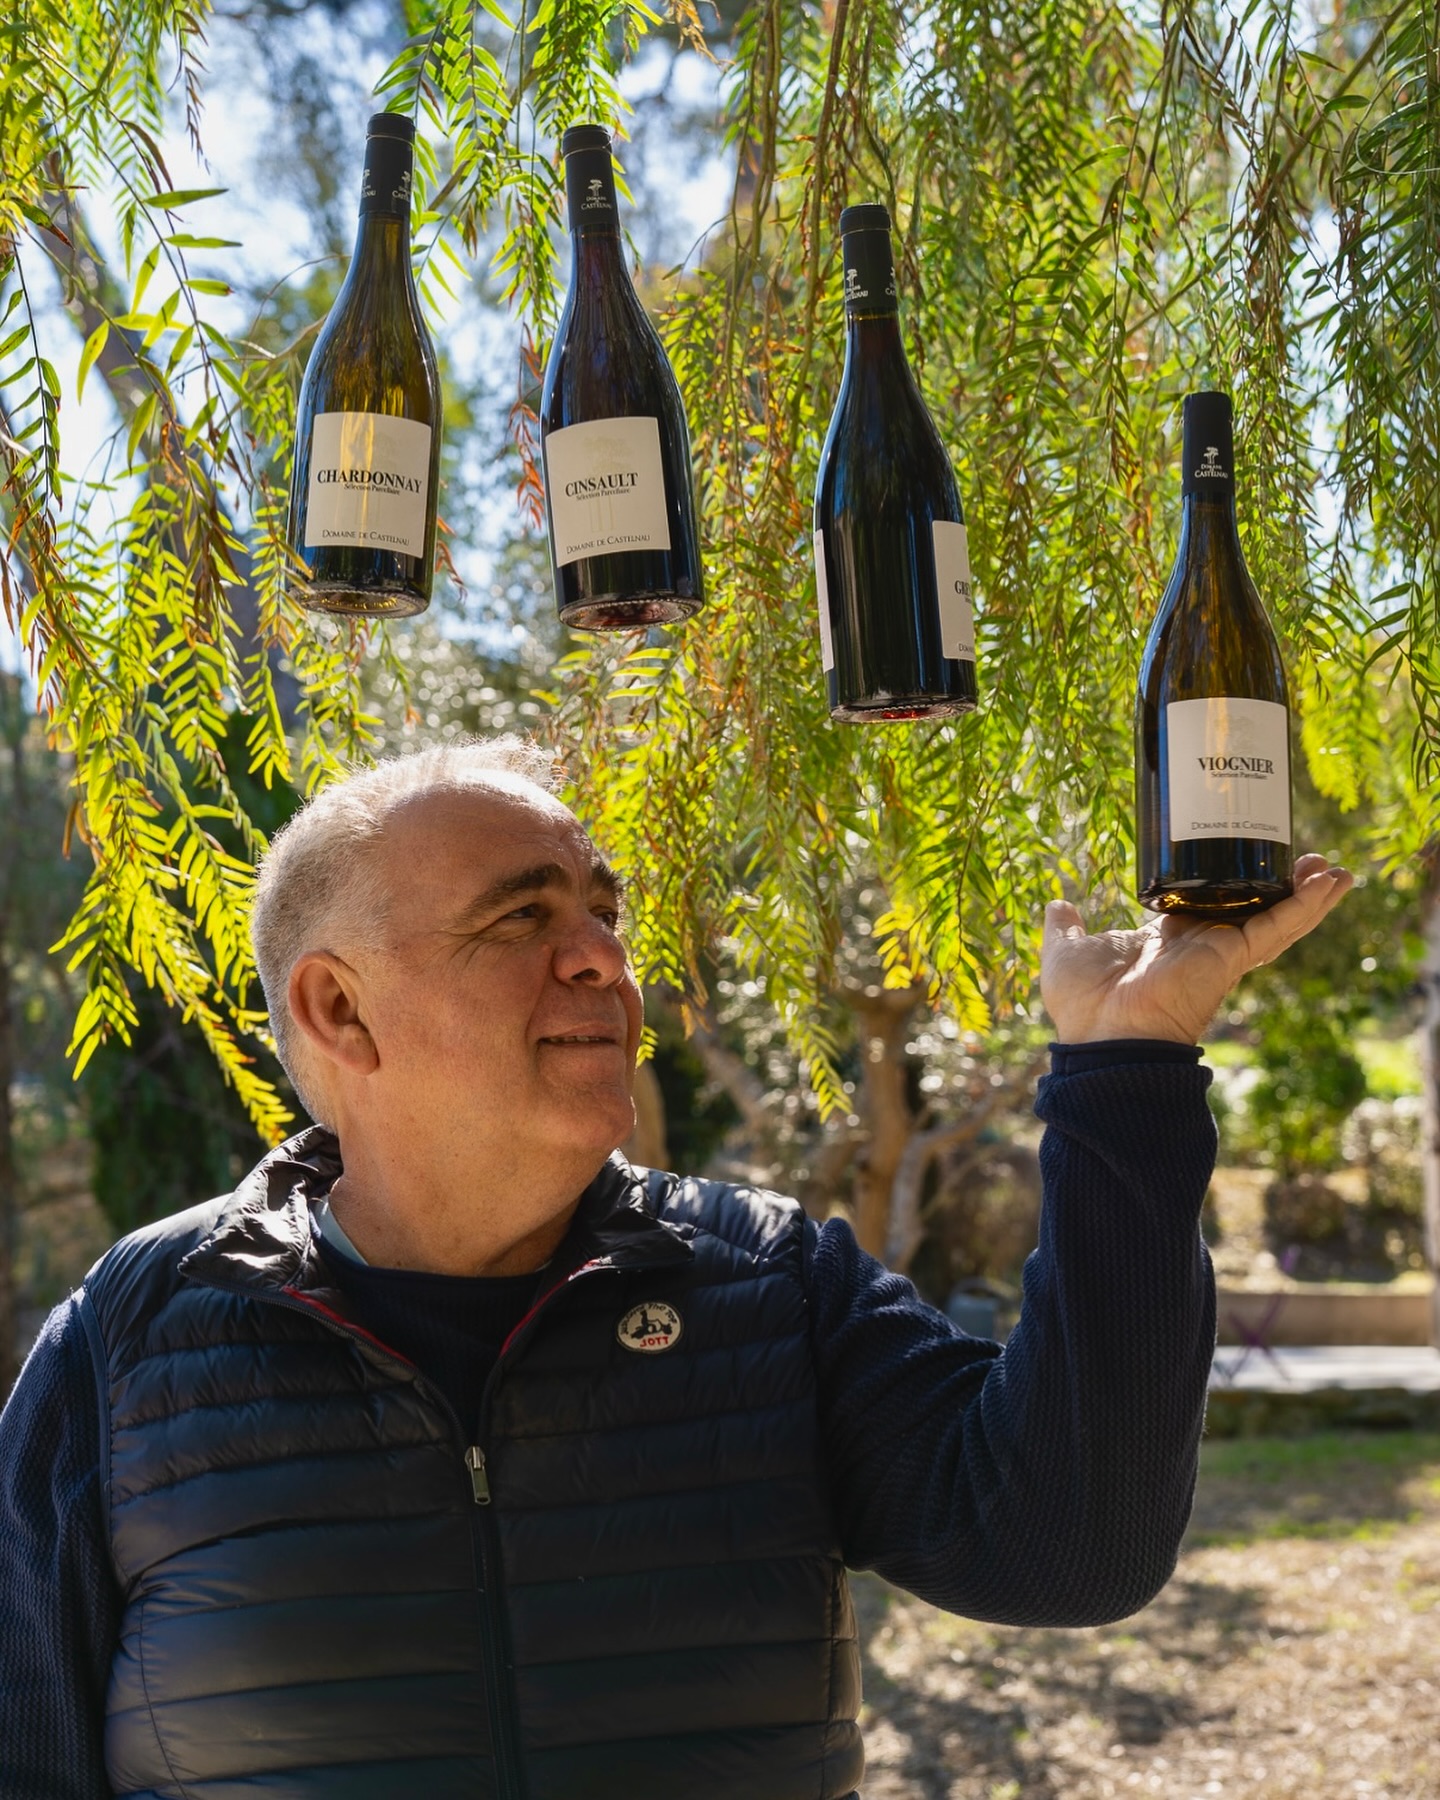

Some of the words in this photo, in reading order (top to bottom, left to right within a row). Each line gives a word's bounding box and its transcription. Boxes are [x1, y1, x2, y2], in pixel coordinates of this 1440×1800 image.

[317, 469, 422, 494] CHARDONNAY
[565, 472, 639, 498] CINSAULT
[1197, 757, 1275, 775] VIOGNIER
[639, 1335, 669, 1348] JOTT
